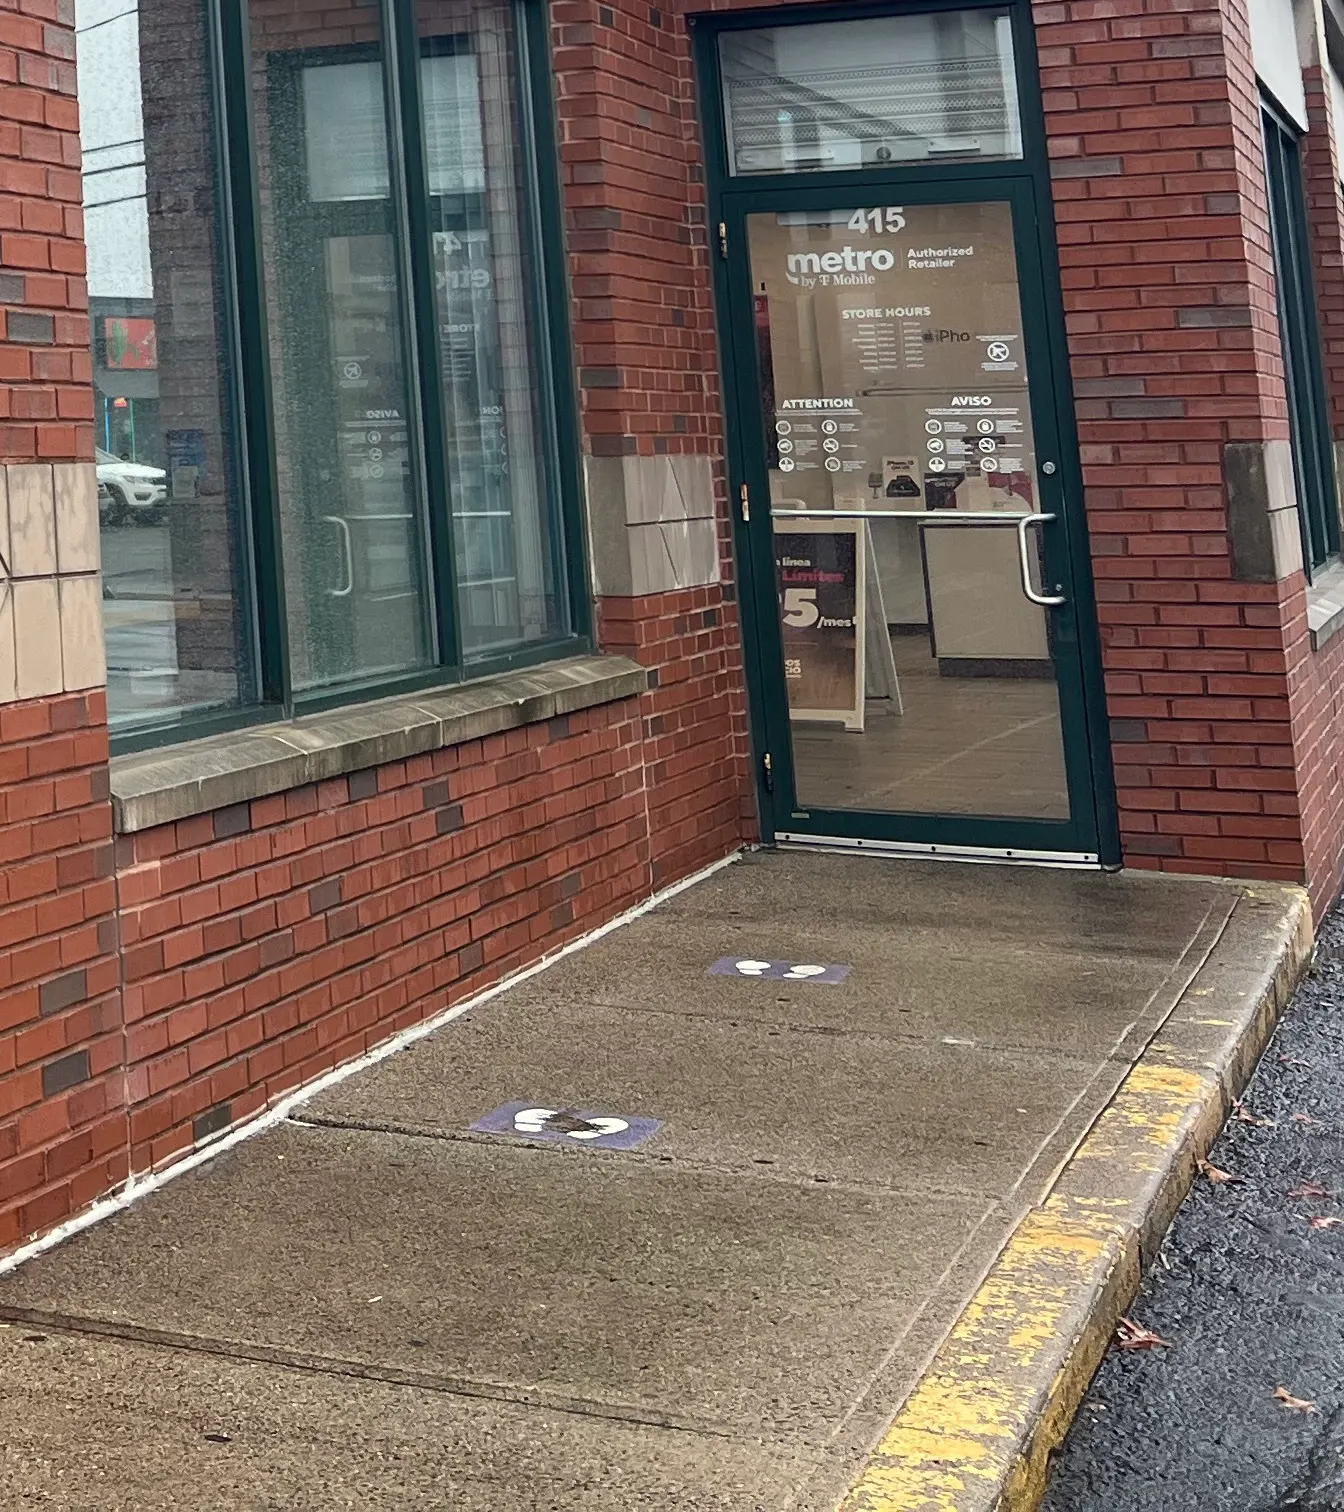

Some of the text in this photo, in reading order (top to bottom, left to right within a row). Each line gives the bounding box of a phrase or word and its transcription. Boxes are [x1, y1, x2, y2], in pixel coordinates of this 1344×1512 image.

[847, 206, 906, 234] 415
[786, 246, 974, 274] metro Authorized
[908, 259, 955, 269] Retailer
[801, 275, 816, 289] by
[832, 273, 875, 286] Mobile
[842, 306, 931, 319] STORE HOURS
[782, 398, 853, 409] ATTENTION
[951, 396, 992, 406] AVISO
